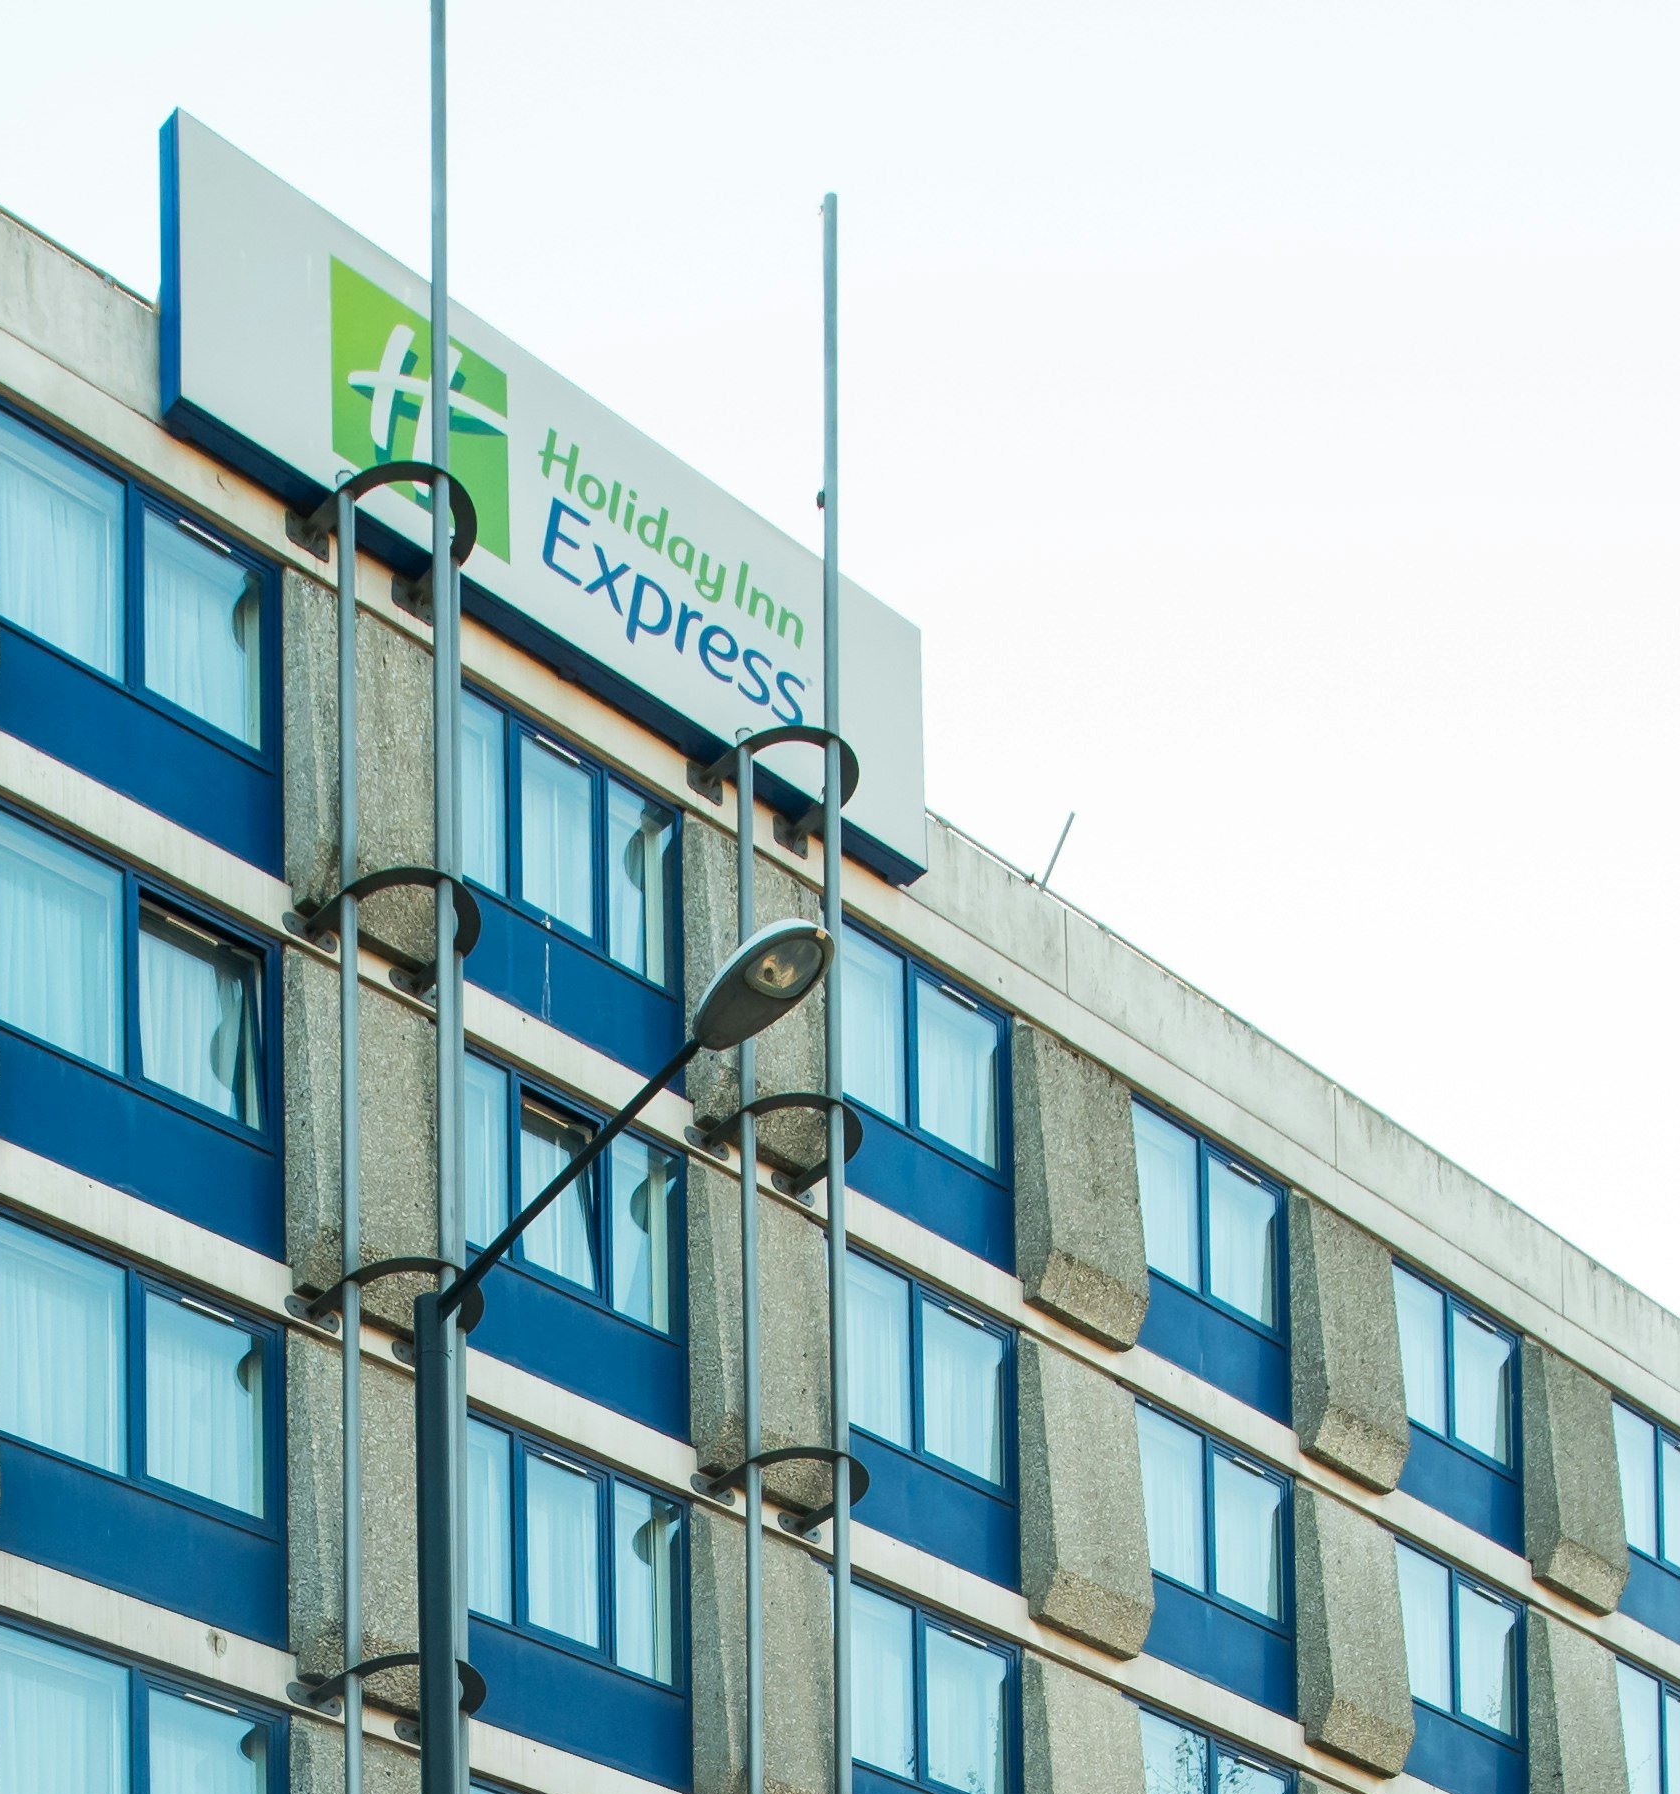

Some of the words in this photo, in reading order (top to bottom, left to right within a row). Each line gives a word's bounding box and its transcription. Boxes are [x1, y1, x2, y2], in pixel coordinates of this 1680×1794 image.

[537, 426, 727, 604] Holiday
[734, 560, 805, 651] Inn
[541, 495, 806, 727] Express
